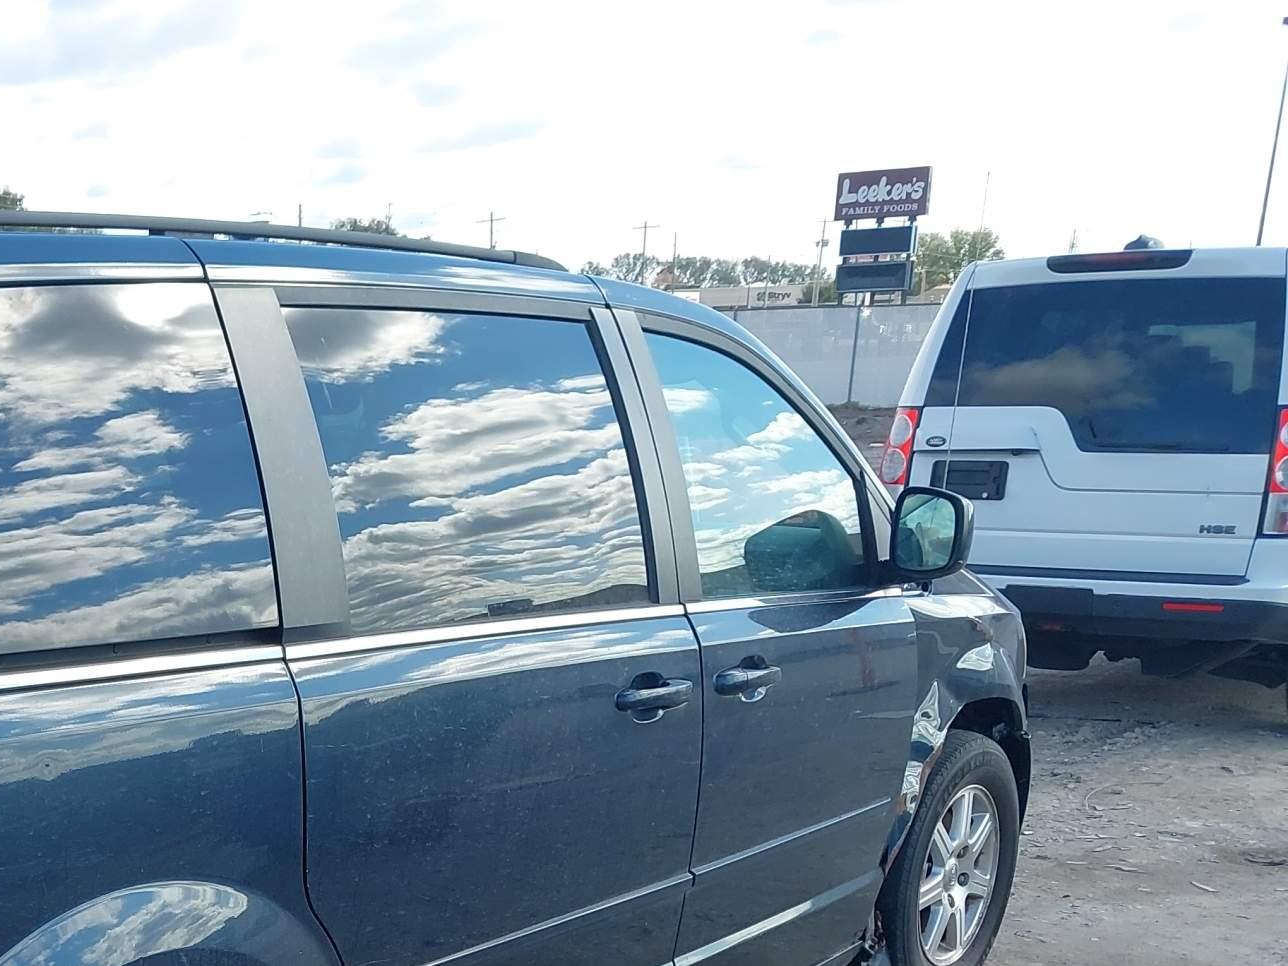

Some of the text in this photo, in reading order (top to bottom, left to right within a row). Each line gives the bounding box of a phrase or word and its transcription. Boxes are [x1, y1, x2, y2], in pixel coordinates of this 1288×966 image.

[838, 176, 925, 204] Leeker's
[841, 203, 919, 216] FAMILY FOODS
[1199, 524, 1237, 535] HSE
